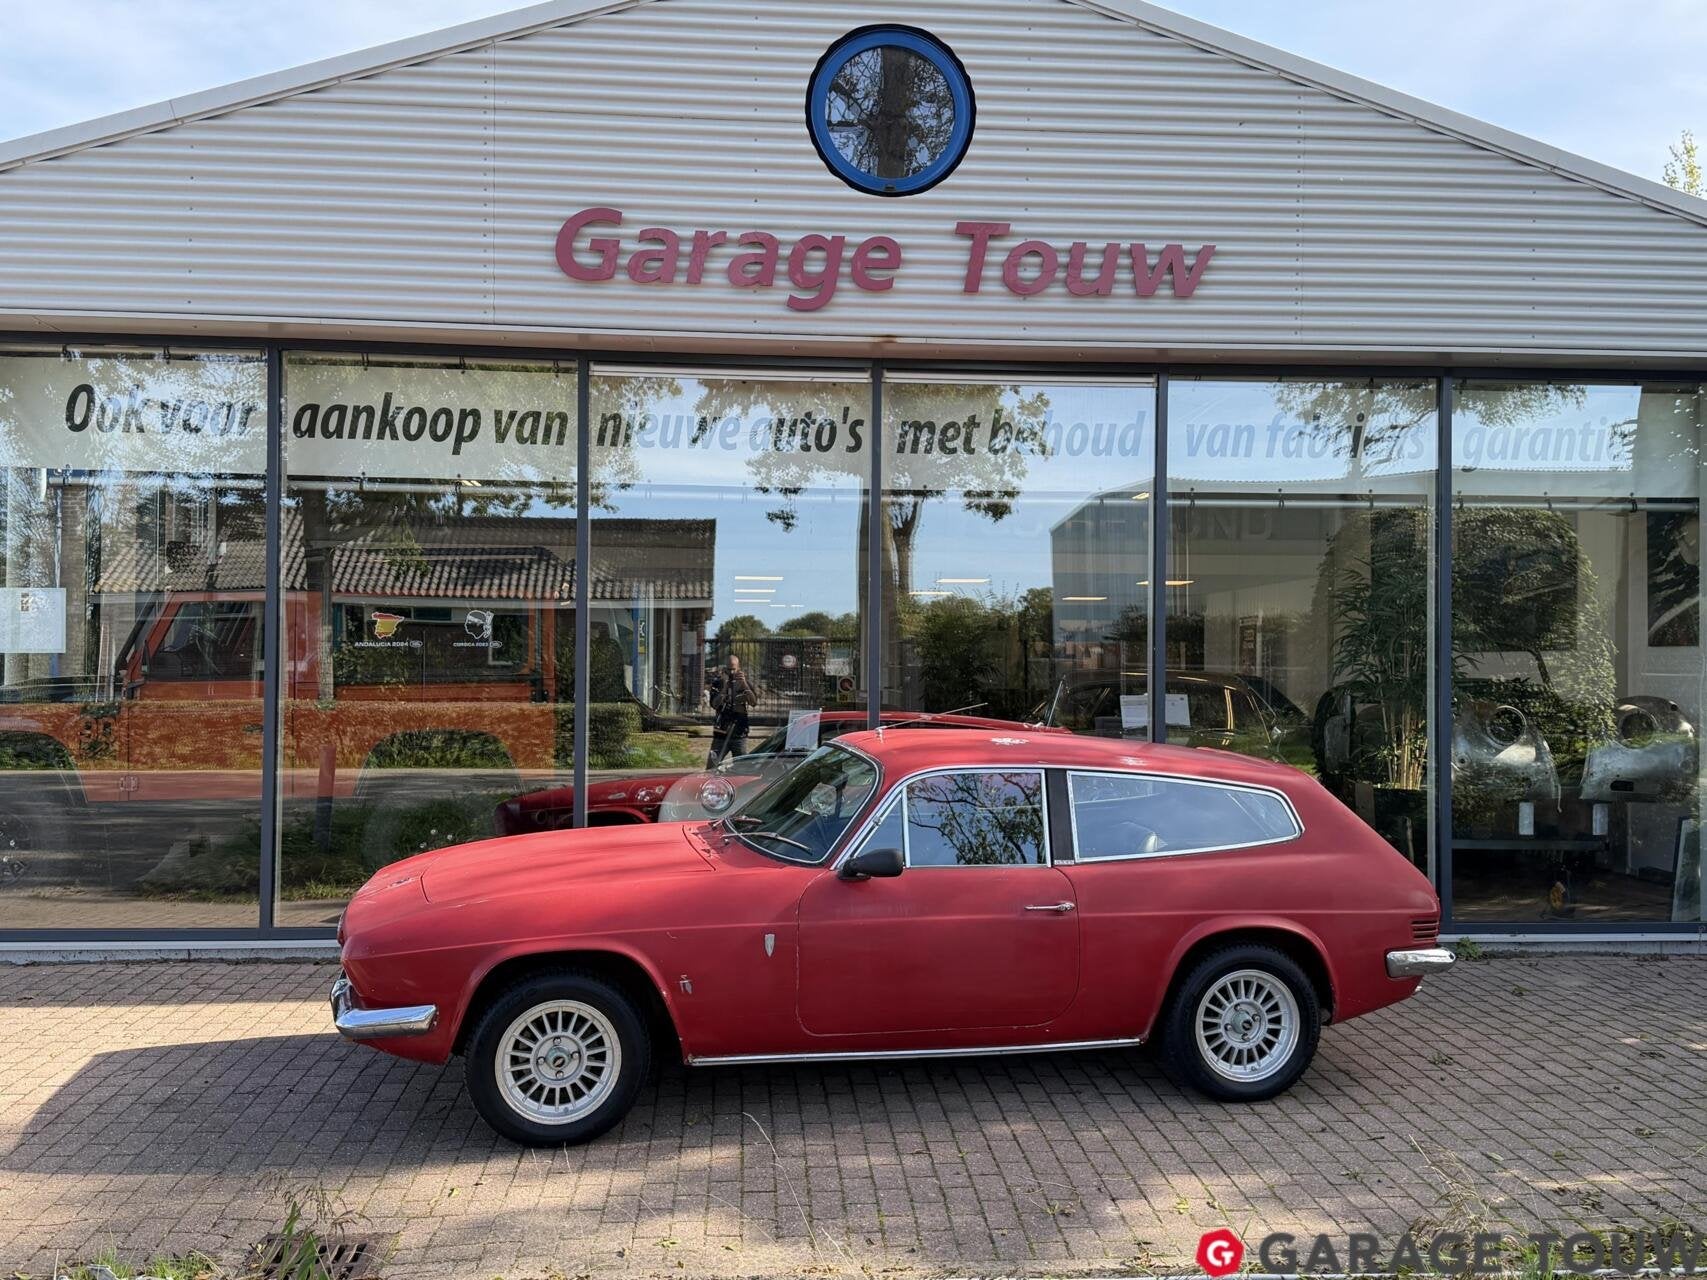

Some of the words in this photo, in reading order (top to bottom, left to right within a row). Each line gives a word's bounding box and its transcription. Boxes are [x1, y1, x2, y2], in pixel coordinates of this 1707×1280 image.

[554, 207, 902, 310] Garage
[954, 221, 1216, 298] Touw
[65, 383, 150, 434] Ook
[158, 397, 257, 437] voor
[292, 392, 482, 456] aankoop
[494, 408, 569, 446] van
[596, 399, 740, 450] nieuwe
[749, 405, 865, 453] auto's
[896, 413, 980, 455] met
[988, 408, 1147, 457] behoud
[1186, 423, 1255, 459] van
